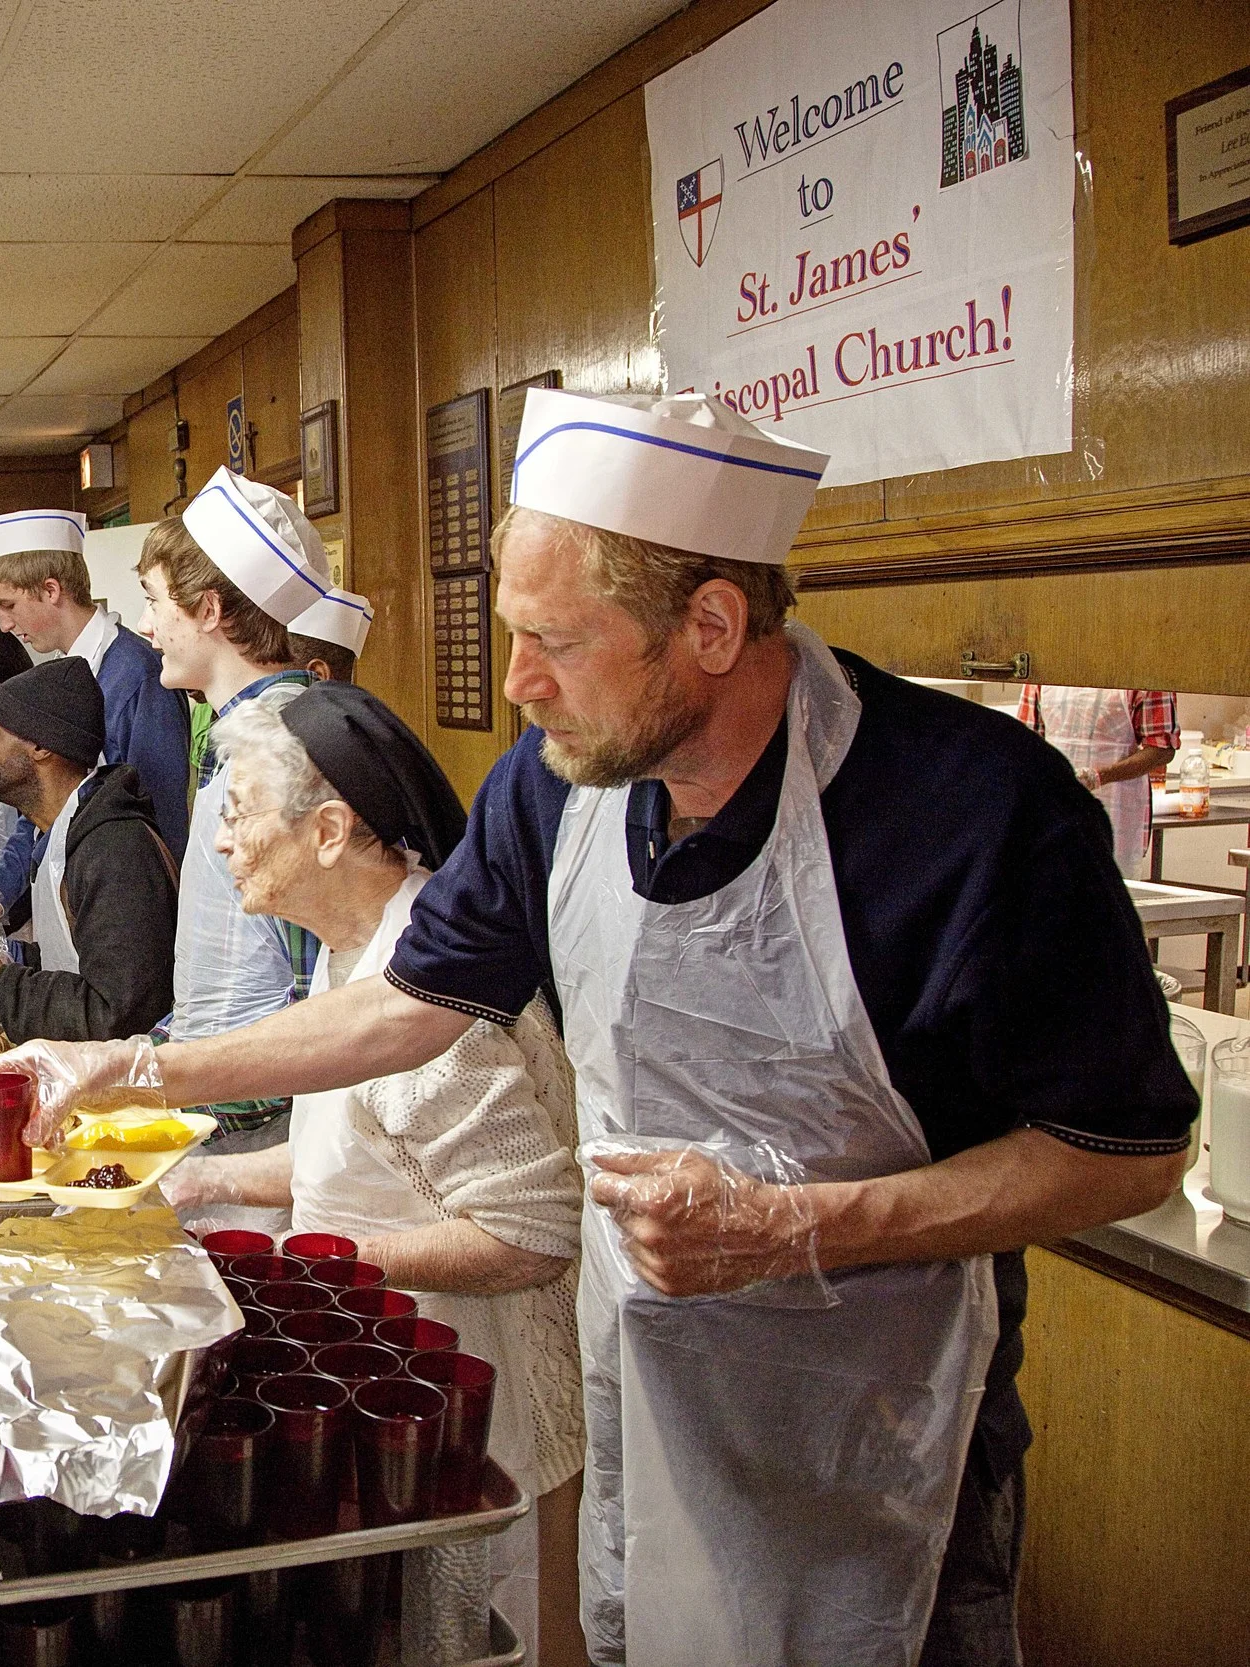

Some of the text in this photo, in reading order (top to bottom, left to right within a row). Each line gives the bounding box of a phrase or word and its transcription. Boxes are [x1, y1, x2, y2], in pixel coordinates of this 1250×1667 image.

[734, 60, 904, 168] Welcome
[1194, 116, 1223, 136] Friend
[1225, 111, 1234, 124] of
[1221, 138, 1239, 154] Lee
[797, 174, 834, 218] to
[737, 271, 779, 324] St.
[834, 284, 1013, 388] Church!
